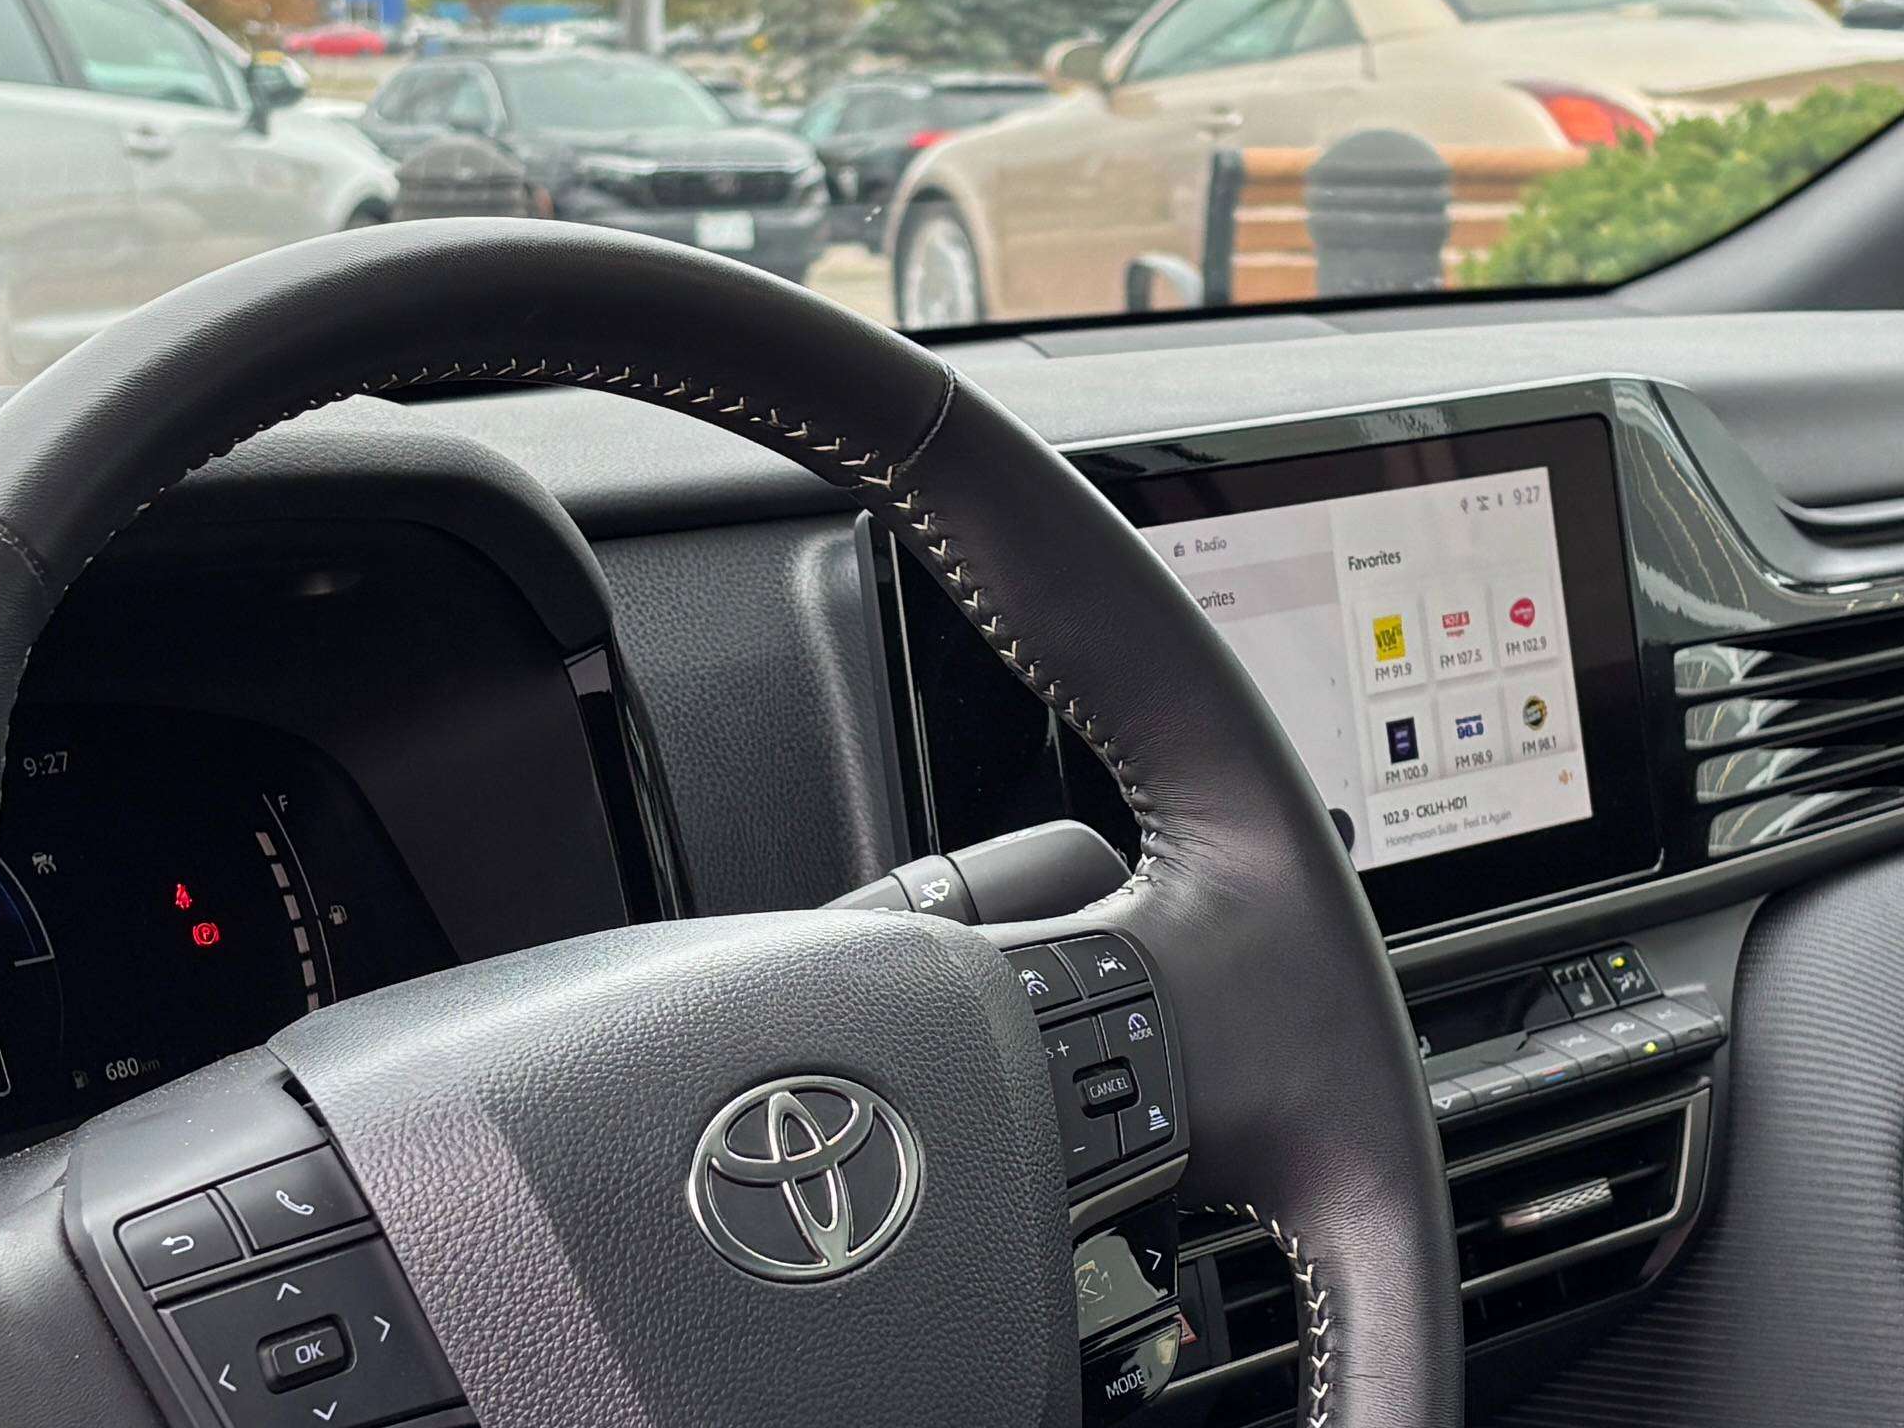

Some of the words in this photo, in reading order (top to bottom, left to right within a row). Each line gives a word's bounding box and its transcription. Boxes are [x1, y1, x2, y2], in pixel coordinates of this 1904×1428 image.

[1513, 485, 1541, 506] 9:27
[1195, 536, 1227, 554] Radio
[1348, 550, 1402, 571] Favorites
[1506, 641, 1521, 656] FM
[1440, 654, 1455, 669] FM
[1375, 667, 1390, 682] FM
[23, 751, 69, 778] 9:27
[1455, 756, 1471, 770] FM
[1386, 771, 1401, 785] FM
[277, 795, 288, 812] F
[1383, 808, 1410, 826] 102.9
[105, 1057, 139, 1081] 680
[1089, 1076, 1129, 1099] CANCEL
[295, 1339, 325, 1364] OK
[1106, 1369, 1146, 1400] MODE
